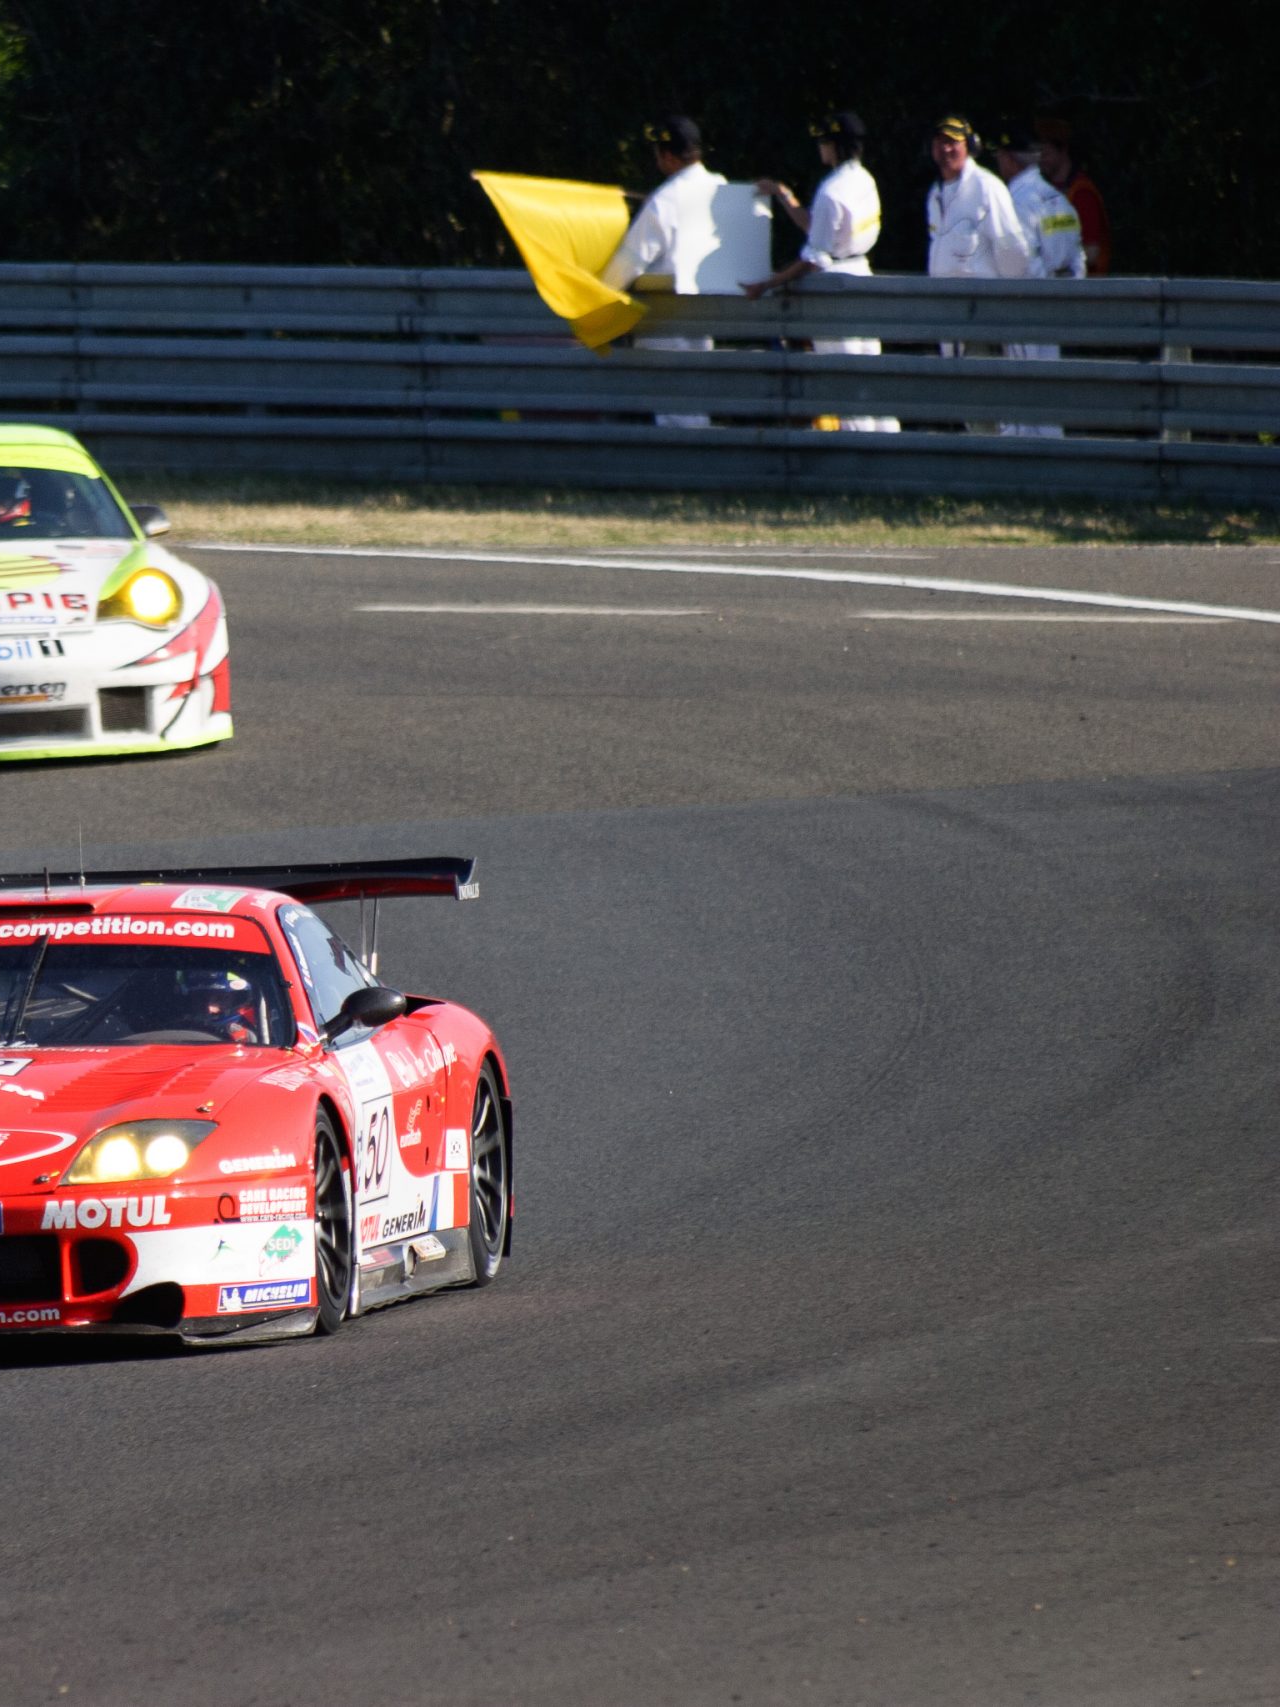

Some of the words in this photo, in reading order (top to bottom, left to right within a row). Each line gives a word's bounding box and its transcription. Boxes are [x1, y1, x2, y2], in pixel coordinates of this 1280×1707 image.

[364, 1105, 390, 1193] 50
[40, 1195, 171, 1230] MOTUL
[239, 1200, 308, 1216] DEVELOPMENT
[382, 1201, 427, 1240] GENERIM
[244, 1283, 308, 1303] MICHELIN
